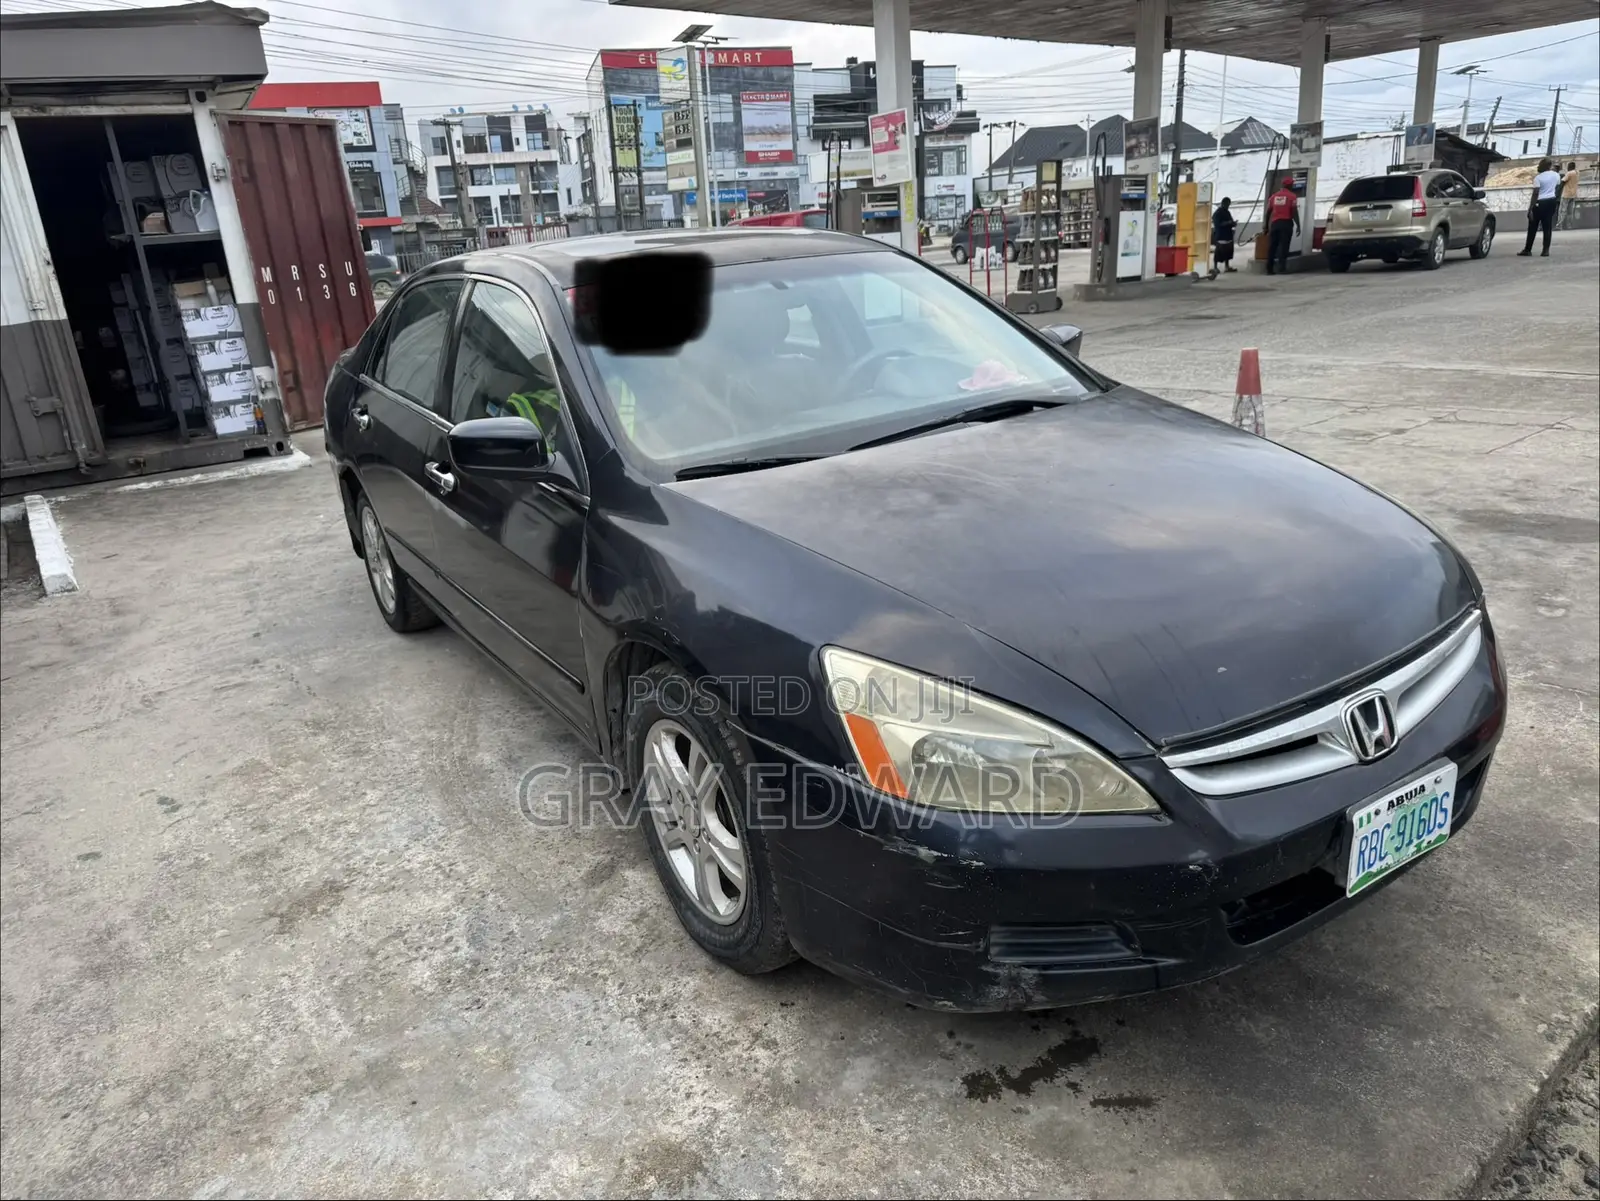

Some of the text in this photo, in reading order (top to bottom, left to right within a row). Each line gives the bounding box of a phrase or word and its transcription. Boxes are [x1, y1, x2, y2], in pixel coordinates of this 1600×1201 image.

[616, 124, 625, 132] TO
[1387, 784, 1426, 811] ABUJA
[1356, 791, 1450, 877] RBC-916DS
